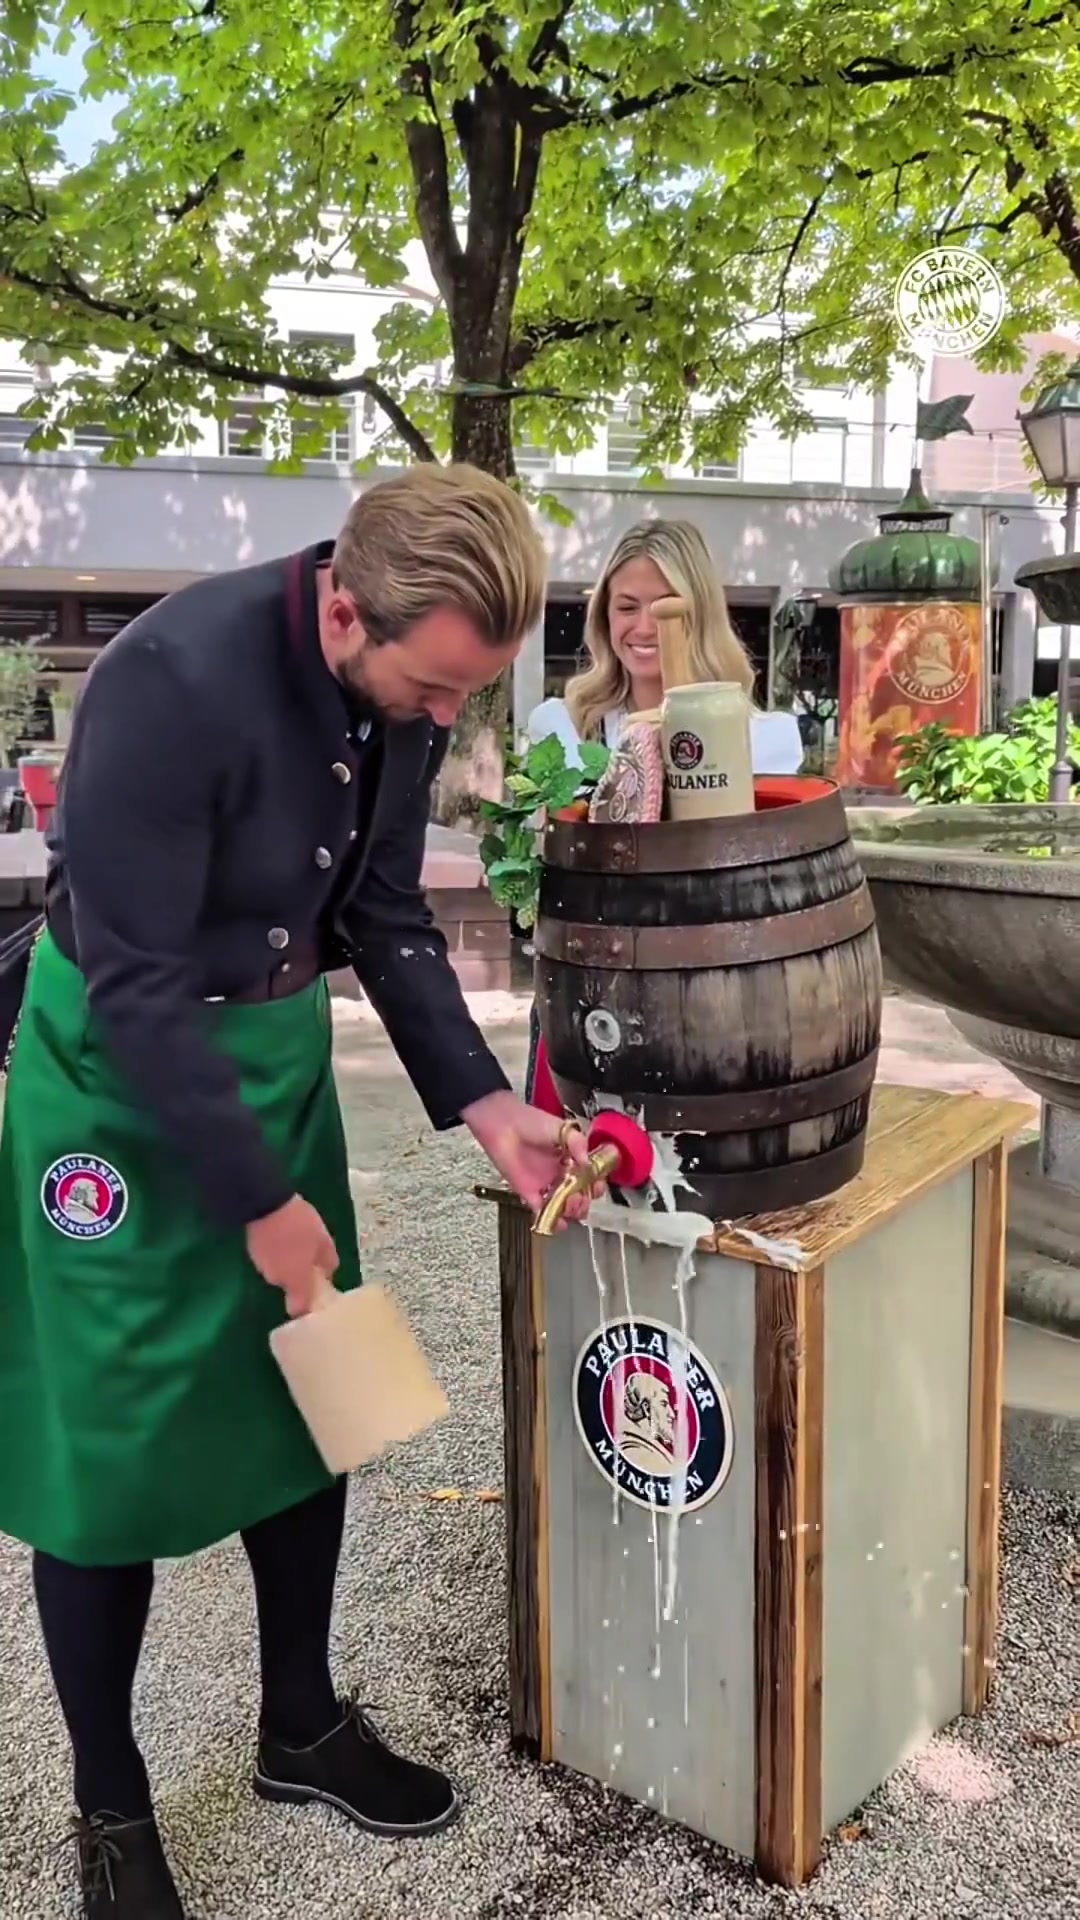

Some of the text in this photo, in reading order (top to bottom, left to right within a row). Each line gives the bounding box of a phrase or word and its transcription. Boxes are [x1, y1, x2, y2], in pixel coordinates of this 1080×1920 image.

[50, 1159, 122, 1193] PAULANER
[585, 1328, 716, 1412] PAULAER
[596, 1438, 704, 1501] MÜNCHN
